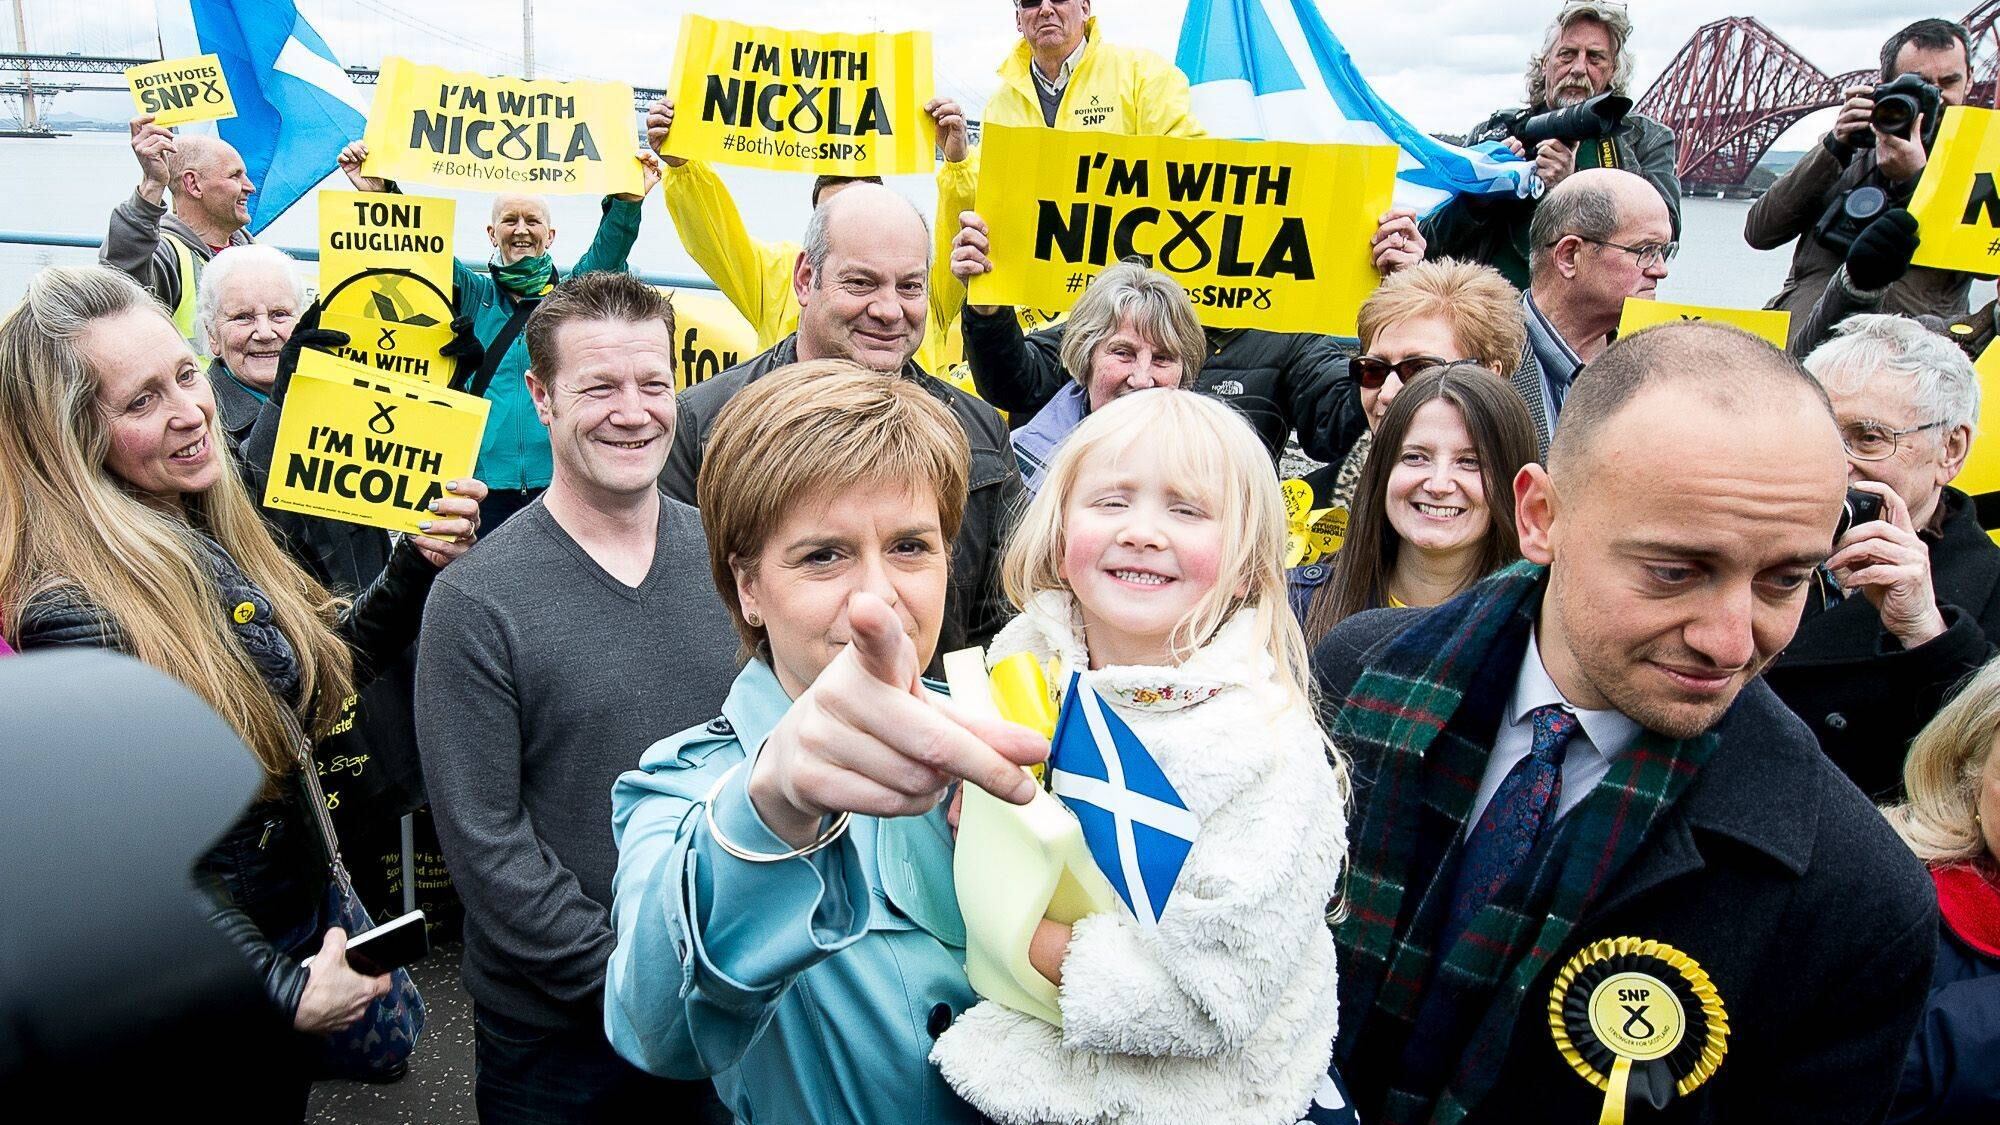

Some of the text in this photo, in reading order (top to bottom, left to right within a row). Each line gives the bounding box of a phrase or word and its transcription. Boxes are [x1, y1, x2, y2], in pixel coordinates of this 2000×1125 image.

[732, 41, 868, 81] I'M WITH
[134, 66, 217, 89] BOTH VOTES
[140, 83, 199, 113] SNP
[439, 83, 575, 119] I'M WITH
[1082, 114, 1106, 126] SNP
[1074, 151, 1292, 206] I'M WITH
[353, 201, 422, 229] TONI
[330, 231, 444, 254] GIUGLIANO
[337, 347, 430, 377] I'M WITH
[308, 426, 443, 475] I'M WITH
[285, 452, 446, 517] NICOLA
[1617, 988, 1650, 1002] SNP
[1607, 1026, 1635, 1046] STRONGER
[1648, 1024, 1671, 1046] SCOTLAND
